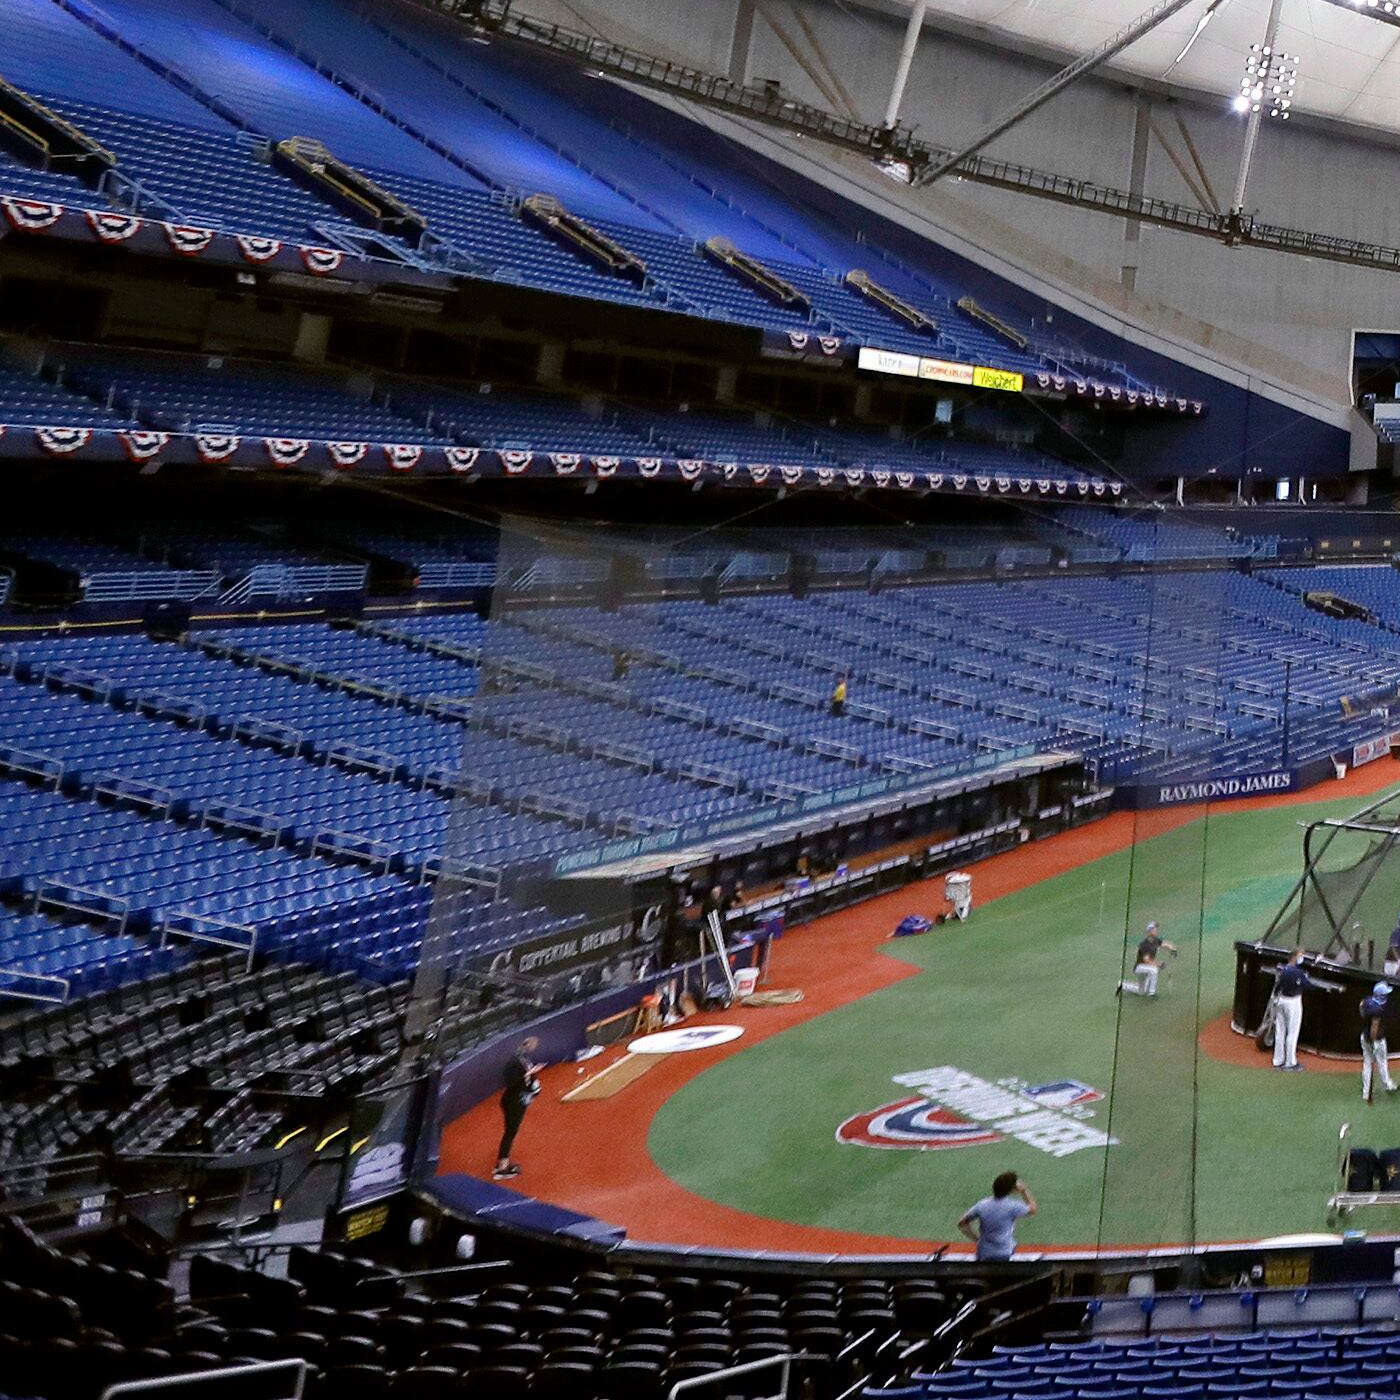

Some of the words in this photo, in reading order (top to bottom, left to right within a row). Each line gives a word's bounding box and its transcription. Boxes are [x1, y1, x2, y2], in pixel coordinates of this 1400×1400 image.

[1159, 776, 1241, 803] RAYMOND
[1240, 772, 1292, 794] JAMES
[519, 938, 579, 974] COPPERTAIL
